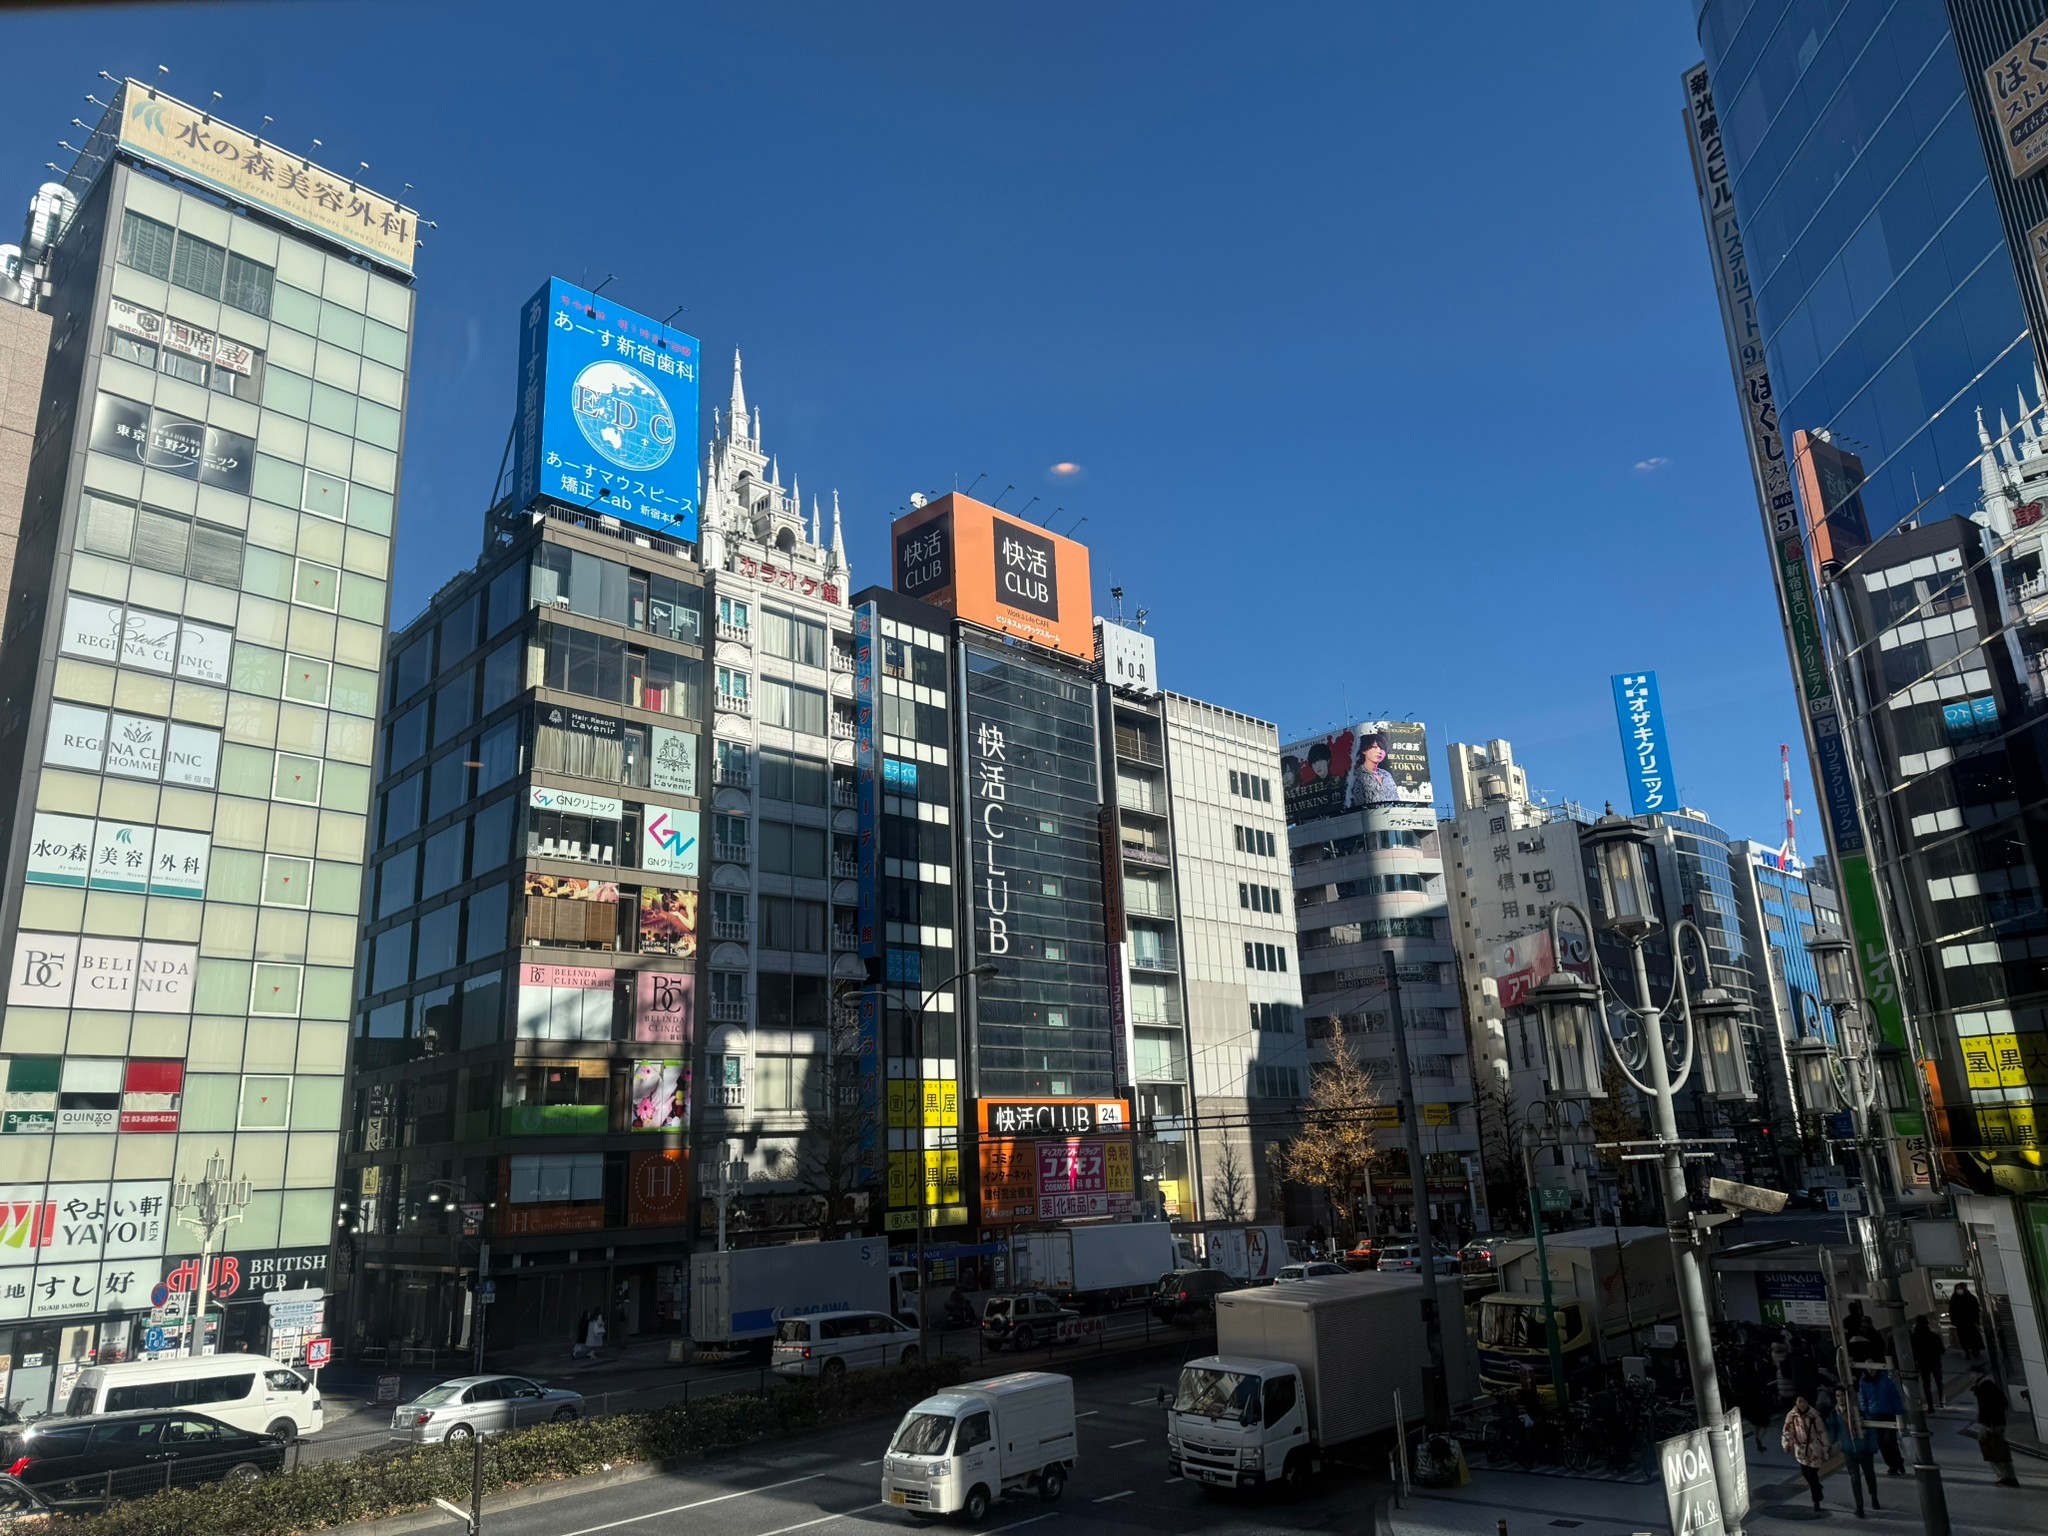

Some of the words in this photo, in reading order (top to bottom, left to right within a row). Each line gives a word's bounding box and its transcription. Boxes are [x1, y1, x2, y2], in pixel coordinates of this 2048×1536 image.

[174, 120, 409, 244] 水の森美容外科
[112, 301, 137, 315] 10F
[165, 318, 240, 363] 相席屋
[554, 310, 695, 383] あーす新宿歯科
[116, 423, 239, 469] 東京上野クリニック
[546, 450, 695, 514] あーすマウスピース
[561, 473, 595, 497] 矯正
[902, 529, 942, 569] 快活
[1002, 537, 1048, 579] 快活
[739, 556, 843, 606] カラオケ館
[904, 559, 942, 590] CLUB
[1005, 571, 1049, 604] CLUB
[1786, 562, 1821, 698] 新宿東口ハートクリニック
[77, 633, 146, 657] REGINA
[153, 650, 213, 671] CLINIC
[571, 713, 588, 722] Hair
[590, 716, 616, 728] Resort
[571, 719, 616, 735] L'avenir
[108, 755, 160, 772] HOMME
[139, 747, 203, 768] CLINIC
[1628, 698, 1664, 809] オザキクリニック
[653, 778, 692, 792] L'avenir
[654, 772, 668, 782] Hair
[670, 775, 692, 785] Resort
[556, 794, 616, 813] GNクリニック
[977, 722, 1009, 955] 快活CLUB
[32, 838, 201, 875] 水の森美容外科
[647, 857, 695, 871] GNクリニック
[1489, 815, 1519, 920] 同栄信用
[82, 955, 189, 976] BELINDA
[554, 968, 597, 978] BELINDA
[1866, 942, 1893, 1006] レイク
[91, 975, 179, 994] CLINIC
[644, 1014, 686, 1024] BELINDA
[647, 1024, 681, 1033] CLINIC
[906, 1092, 957, 1114] 大黒屋
[63, 1112, 113, 1123] QUINTO
[995, 1104, 1091, 1133] 快活CLUB
[992, 1151, 1024, 1164] コミック
[1107, 1145, 1129, 1161] 免税
[1905, 1136, 1929, 1176] ほぐし
[984, 1168, 1033, 1184] インターネット
[1043, 1156, 1101, 1178] コスモス
[1108, 1164, 1129, 1178] TAX
[1044, 1182, 1071, 1191] COSMOS
[1108, 1178, 1131, 1189] FREE
[1543, 1188, 1564, 1198] モア
[63, 1195, 163, 1221] やよい軒
[1040, 1199, 1054, 1217] 薬
[1056, 1198, 1087, 1214] 化粧品
[62, 1221, 148, 1247] YAYOI
[148, 1219, 159, 1243] KEN
[167, 1255, 241, 1298] HUB
[249, 1253, 328, 1273] BRITISH
[249, 1272, 288, 1291] PUB
[1764, 1272, 1821, 1284] SUBNADE
[0, 1283, 26, 1299] 地
[37, 1303, 60, 1312] TSUKIJI
[61, 1301, 90, 1311] SUSHIKO
[1763, 1303, 1782, 1319] 14
[1667, 1445, 1711, 1489] MOA
